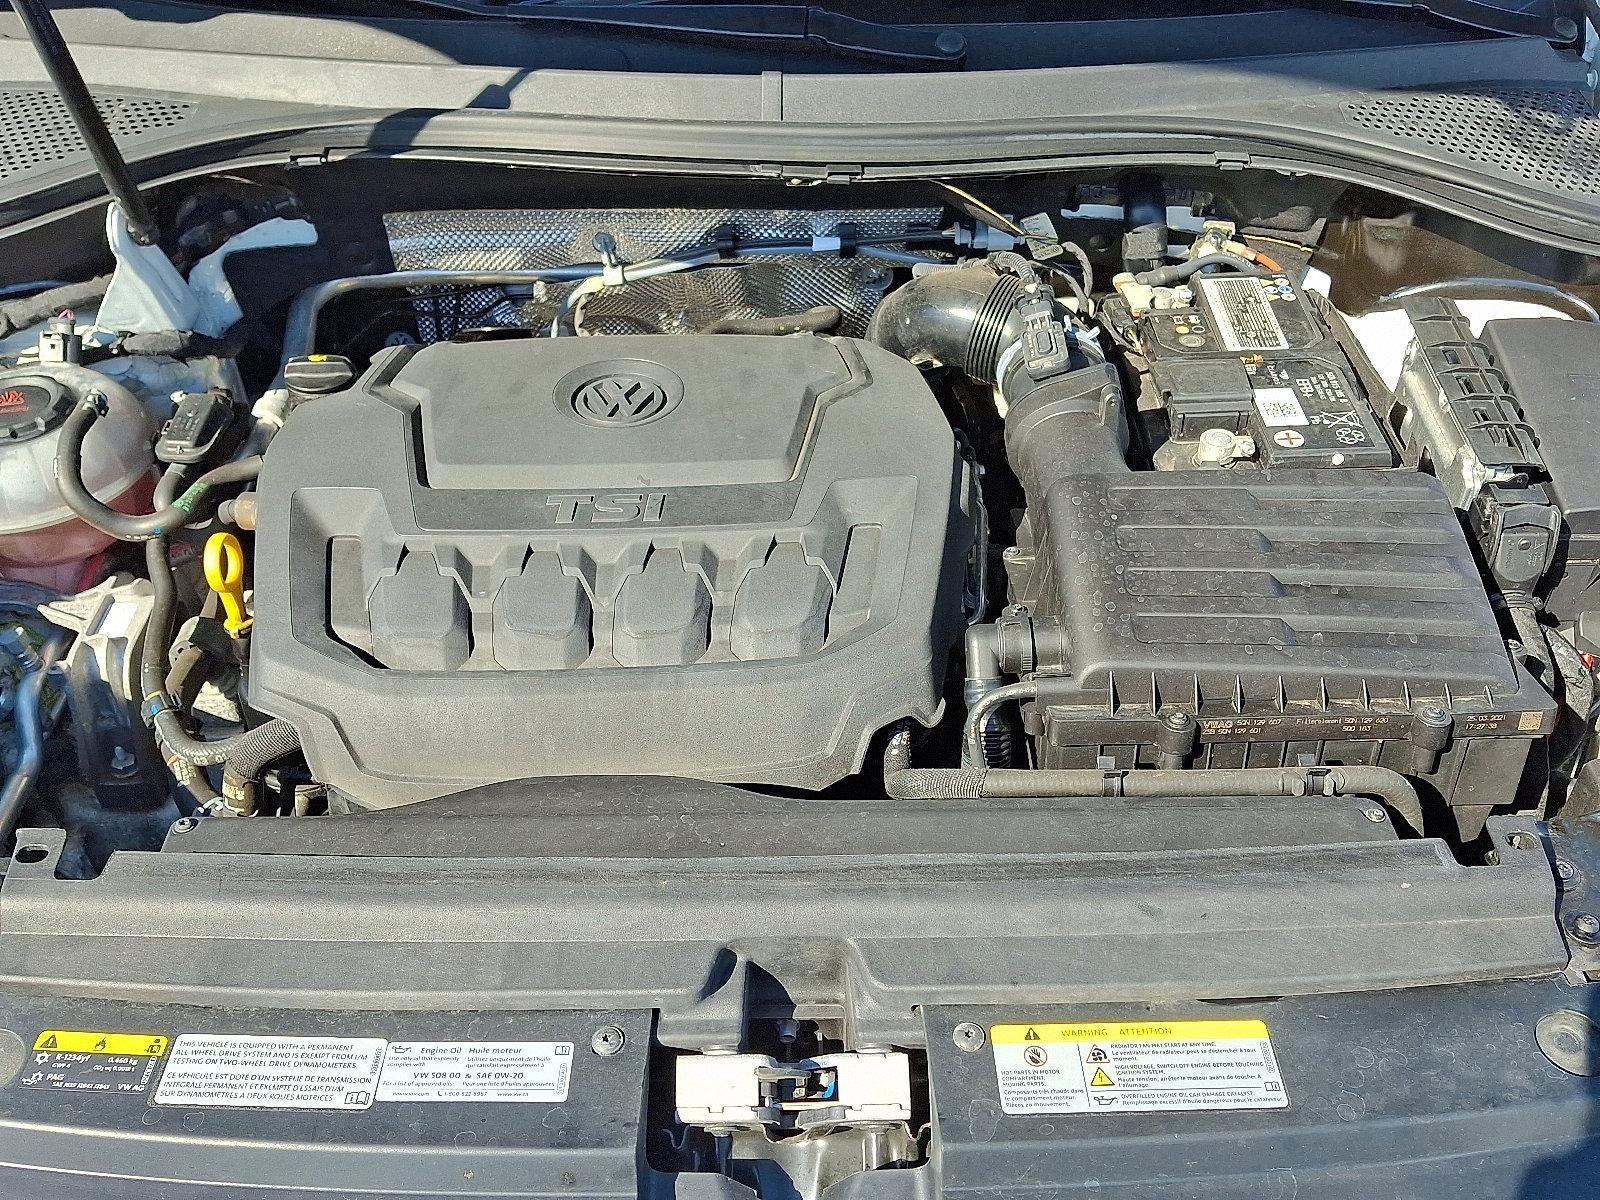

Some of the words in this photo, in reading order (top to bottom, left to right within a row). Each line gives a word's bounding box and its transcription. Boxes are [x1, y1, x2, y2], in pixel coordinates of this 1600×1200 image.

[546, 493, 667, 524] TSI
[1061, 1029, 1108, 1037] WARNING
[1119, 1027, 1173, 1036] ATTENTION
[238, 1042, 276, 1050] EQUIPPED
[420, 1047, 448, 1055] Engine
[55, 1053, 92, 1064] R-1234yf
[219, 1058, 266, 1067] TWO-WHEEL
[46, 1073, 65, 1081] PAG
[316, 1076, 372, 1084] TRANSMISSION
[295, 1094, 334, 1102] MOTRICES
